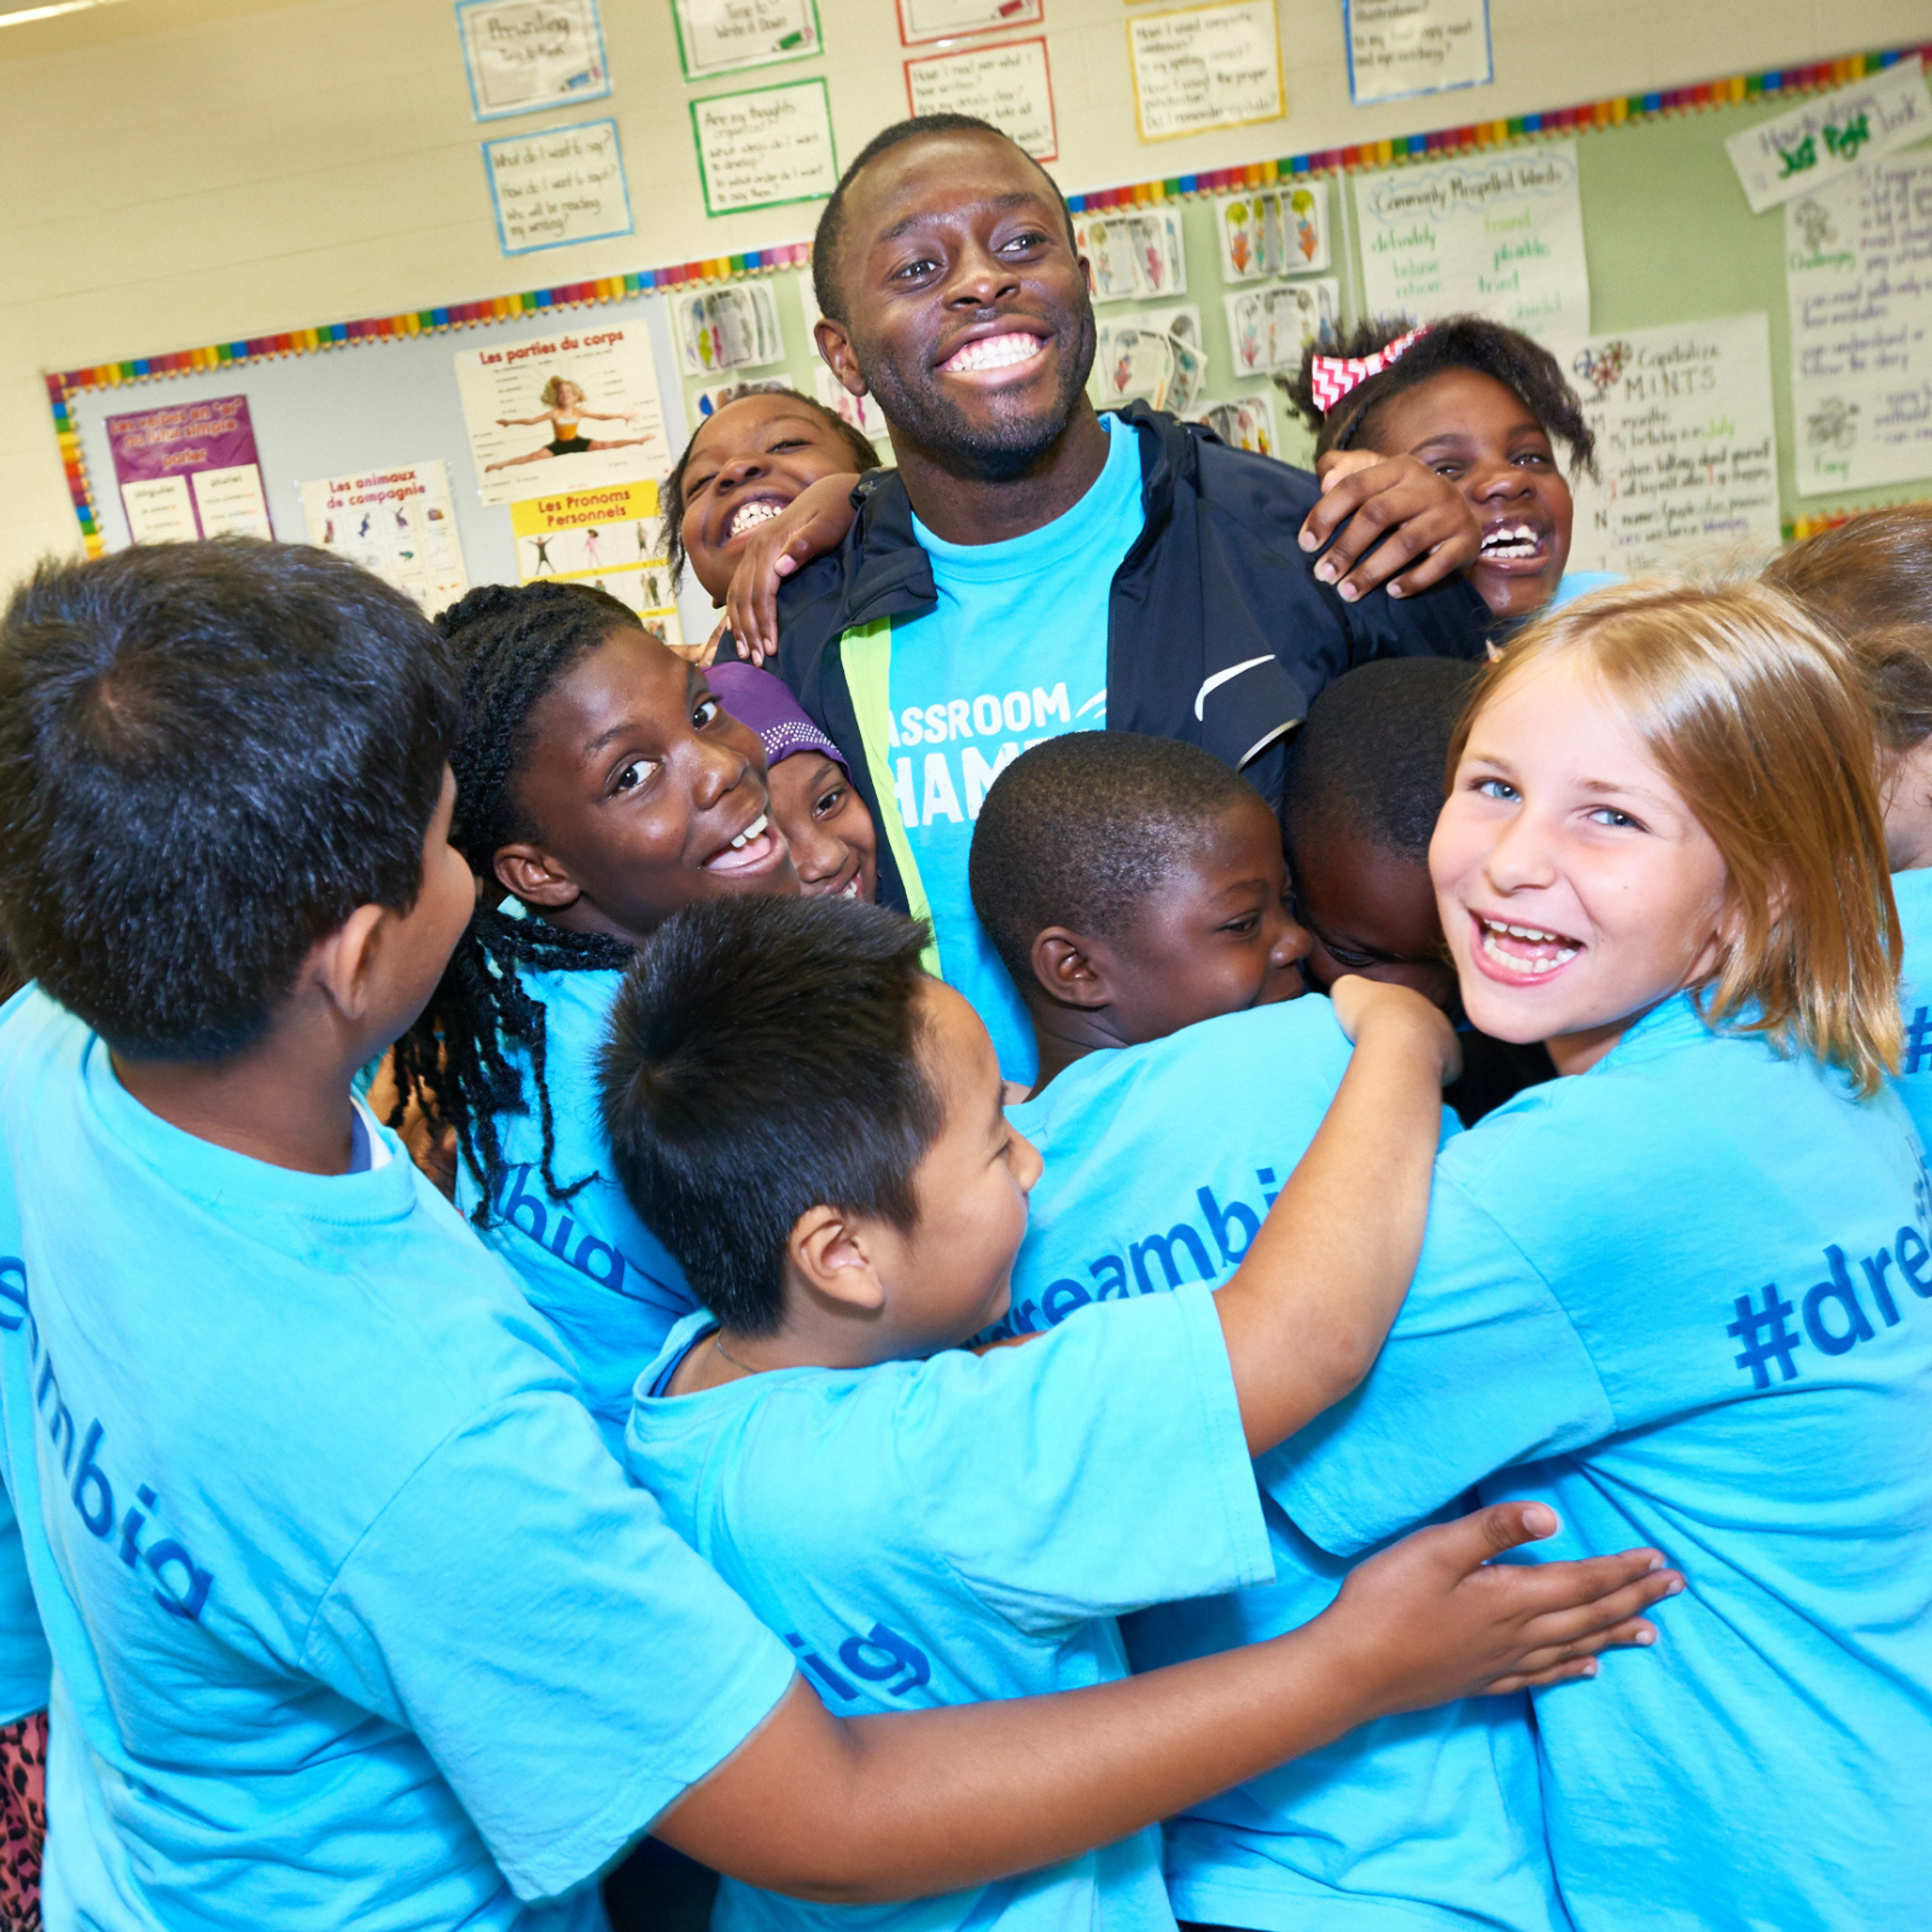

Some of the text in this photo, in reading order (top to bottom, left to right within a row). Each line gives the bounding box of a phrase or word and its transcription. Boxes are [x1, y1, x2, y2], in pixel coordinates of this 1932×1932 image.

[479, 351, 502, 365] Les
[506, 341, 556, 365] parties
[561, 336, 579, 351] du
[584, 330, 624, 348] corps
[1625, 365, 1717, 401] MINTS
[330, 469, 417, 494] Les animaux
[327, 481, 426, 509] de compagnie
[538, 489, 631, 514] Les Pronoms
[547, 505, 626, 527] Personnels
